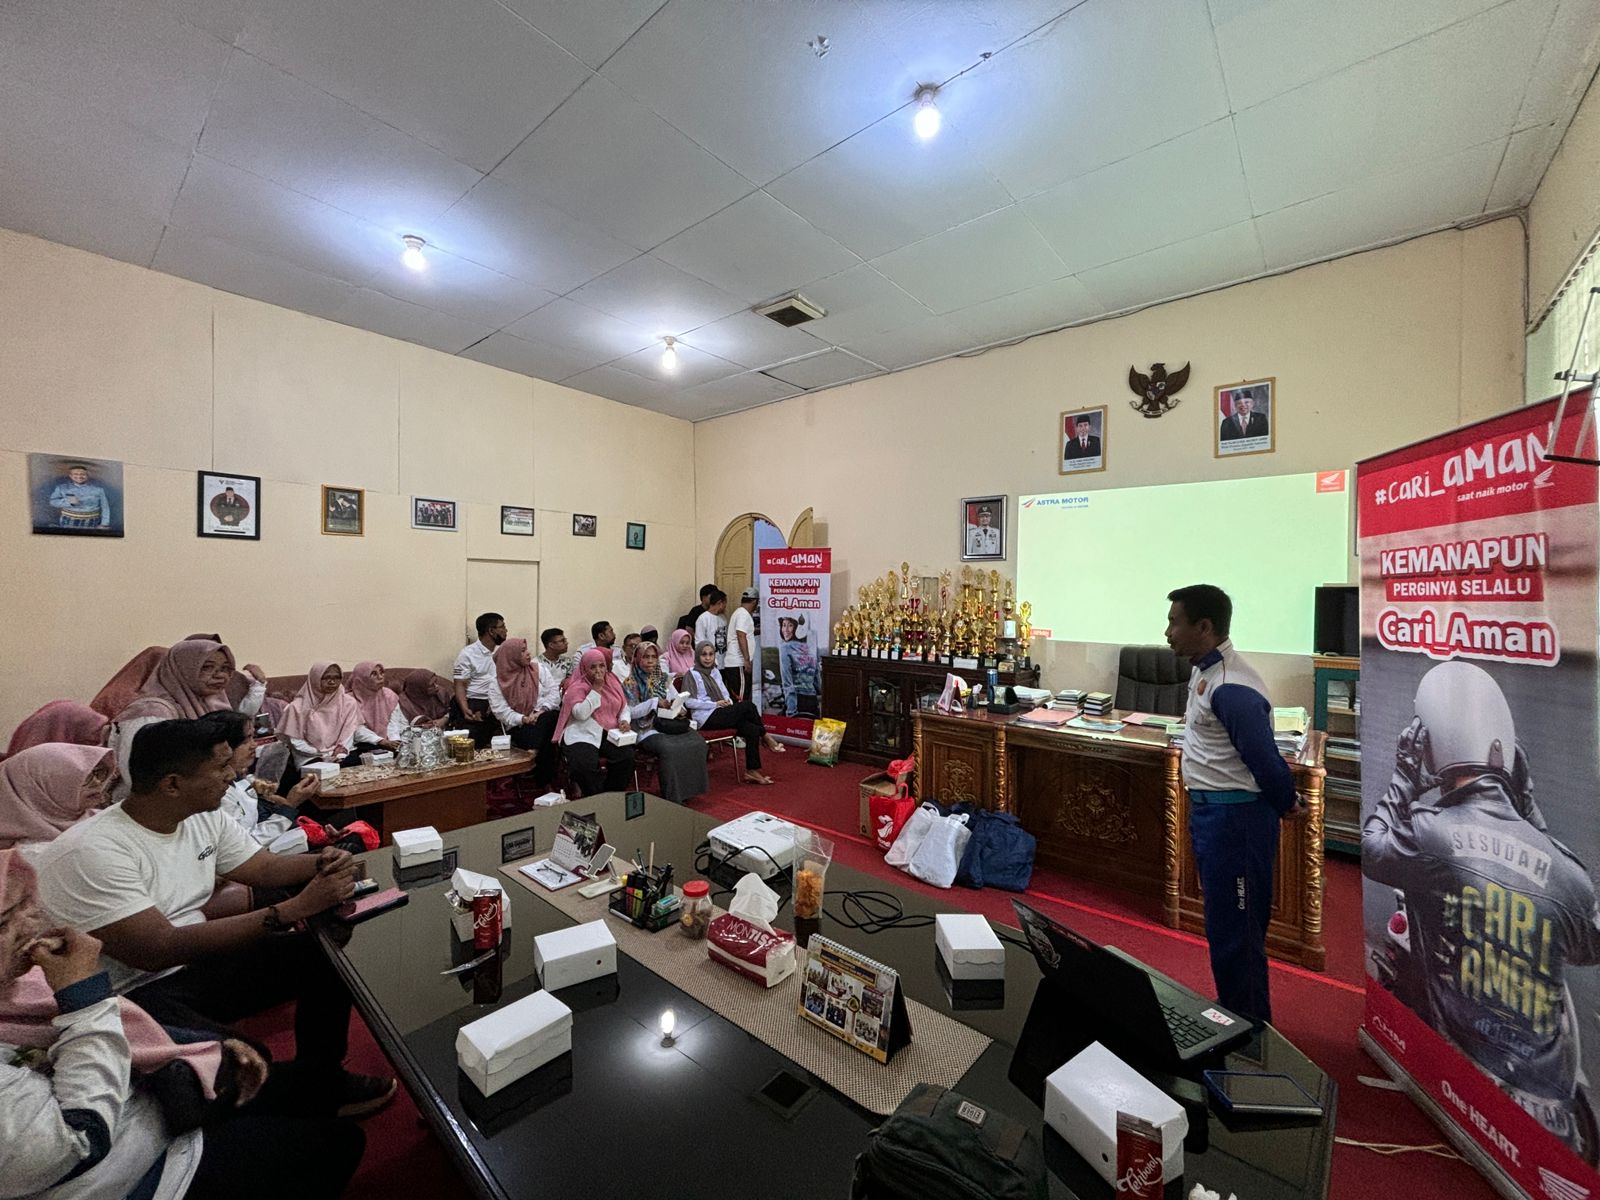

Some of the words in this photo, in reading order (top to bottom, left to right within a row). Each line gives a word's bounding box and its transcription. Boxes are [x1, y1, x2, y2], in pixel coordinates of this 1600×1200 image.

[1061, 496, 1089, 504] MOTOR
[1456, 493, 1474, 502] saat
[1475, 484, 1495, 498] naik
[1496, 482, 1530, 495] motor
[1381, 535, 1546, 575] KEMANAPUN
[769, 579, 820, 587] KEMANAPUN
[1393, 580, 1458, 597] PERGINYA
[1460, 578, 1531, 596] SELALU
[1382, 614, 1553, 655] Cari_Aman
[1452, 831, 1549, 882] SESUDAH
[1441, 1080, 1468, 1116] One
